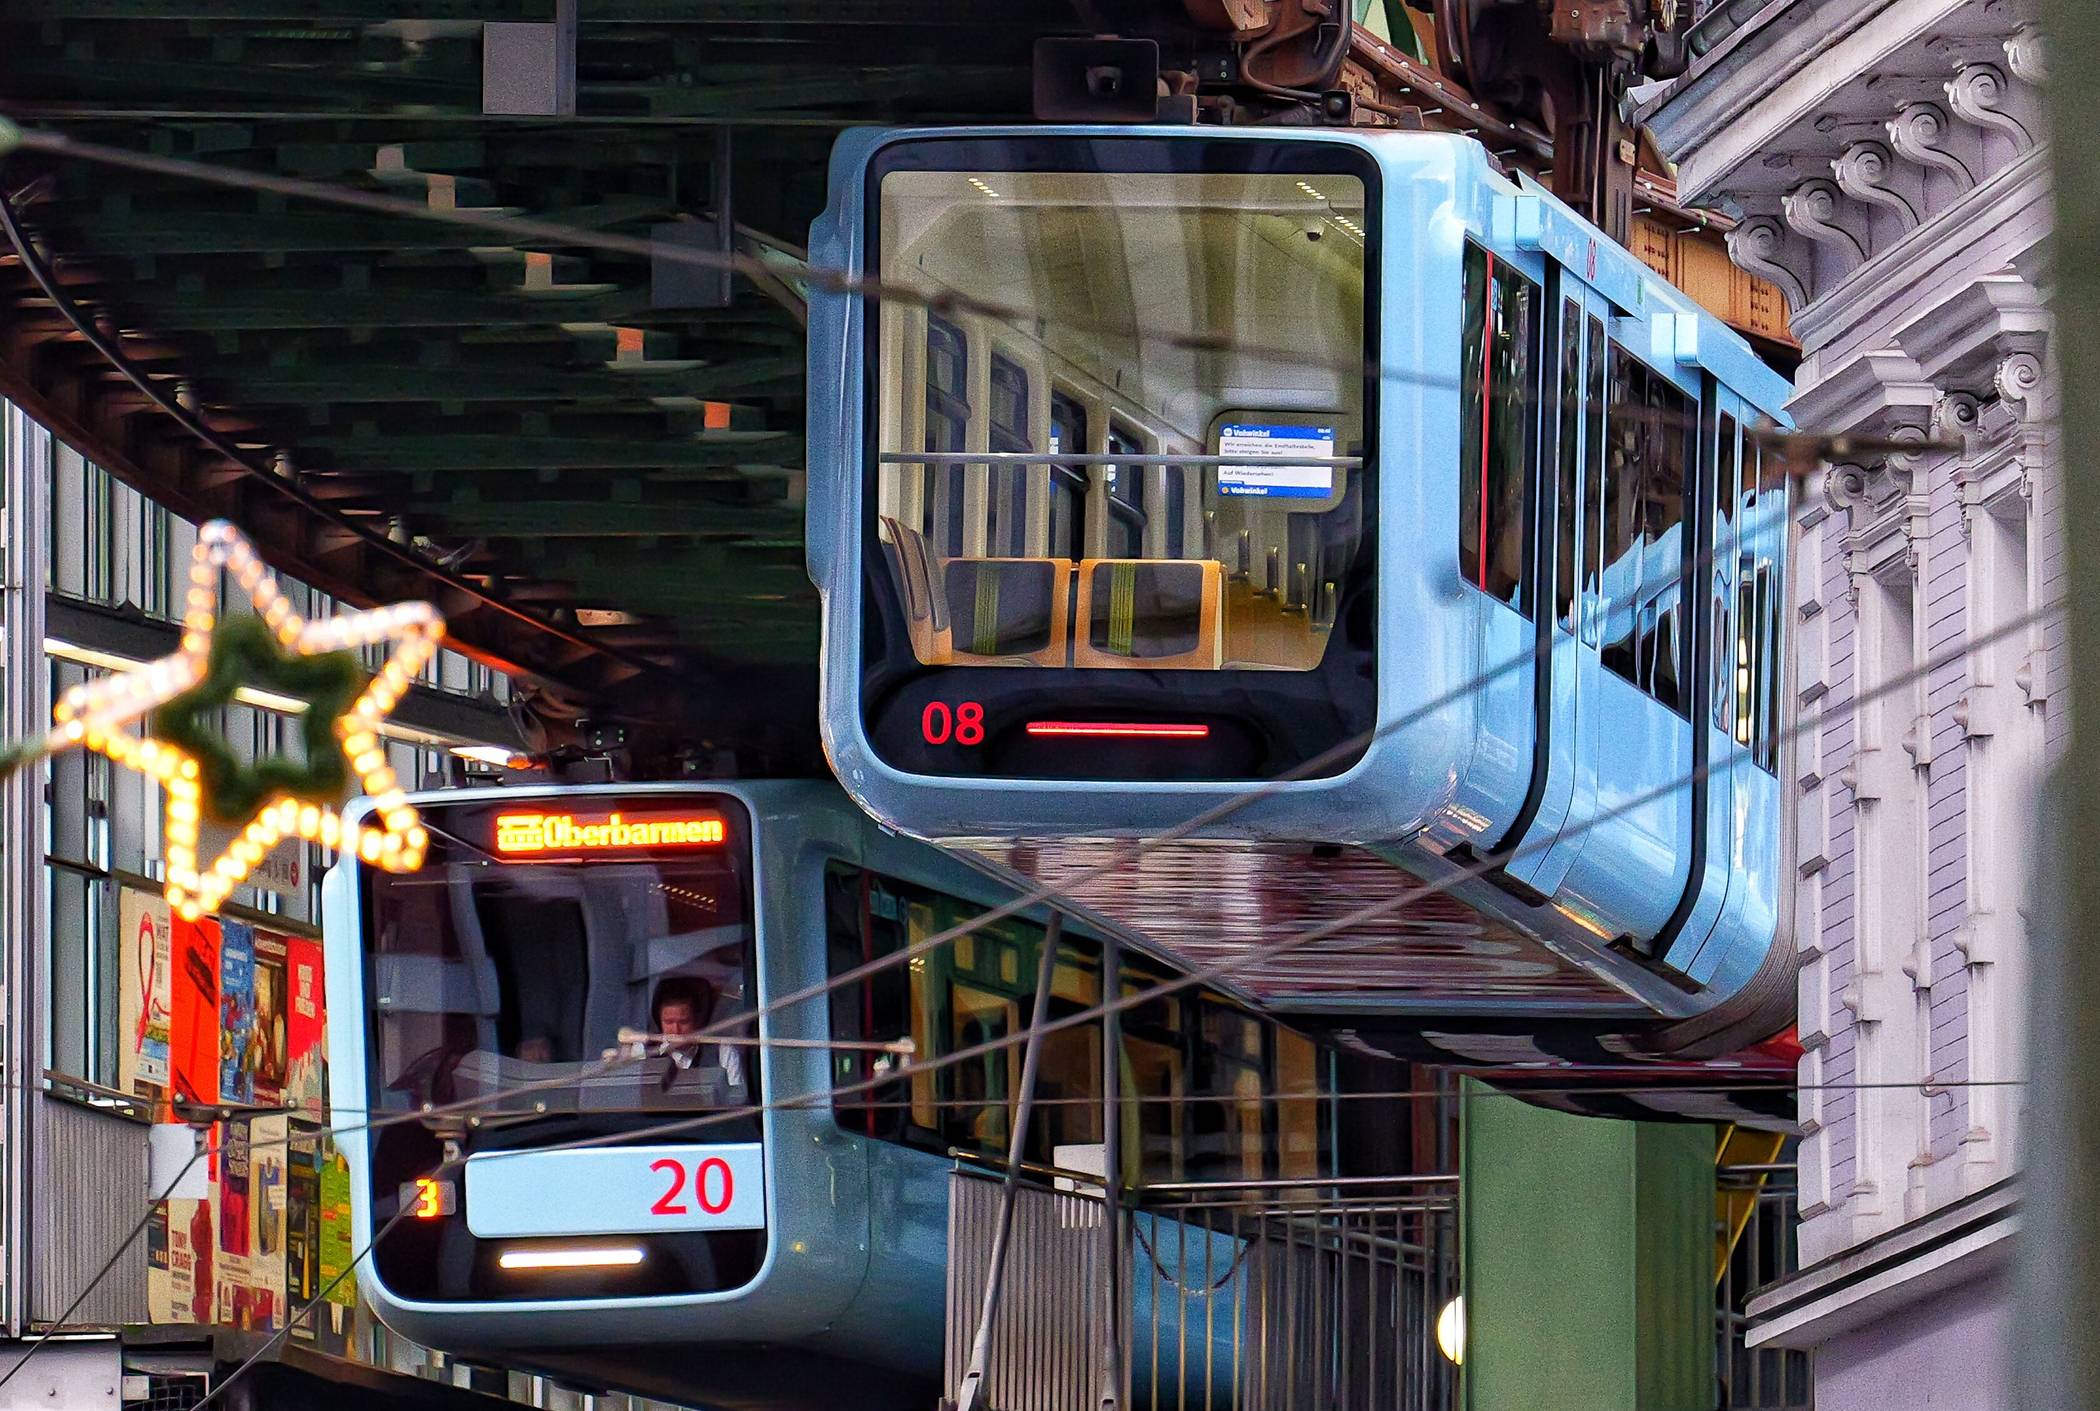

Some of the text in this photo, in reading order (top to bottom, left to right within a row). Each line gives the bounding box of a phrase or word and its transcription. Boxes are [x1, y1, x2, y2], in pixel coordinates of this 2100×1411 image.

[921, 701, 985, 745] 08
[542, 813, 724, 848] Oberbarmen
[416, 1178, 439, 1218] 3
[649, 1157, 735, 1215] 20
